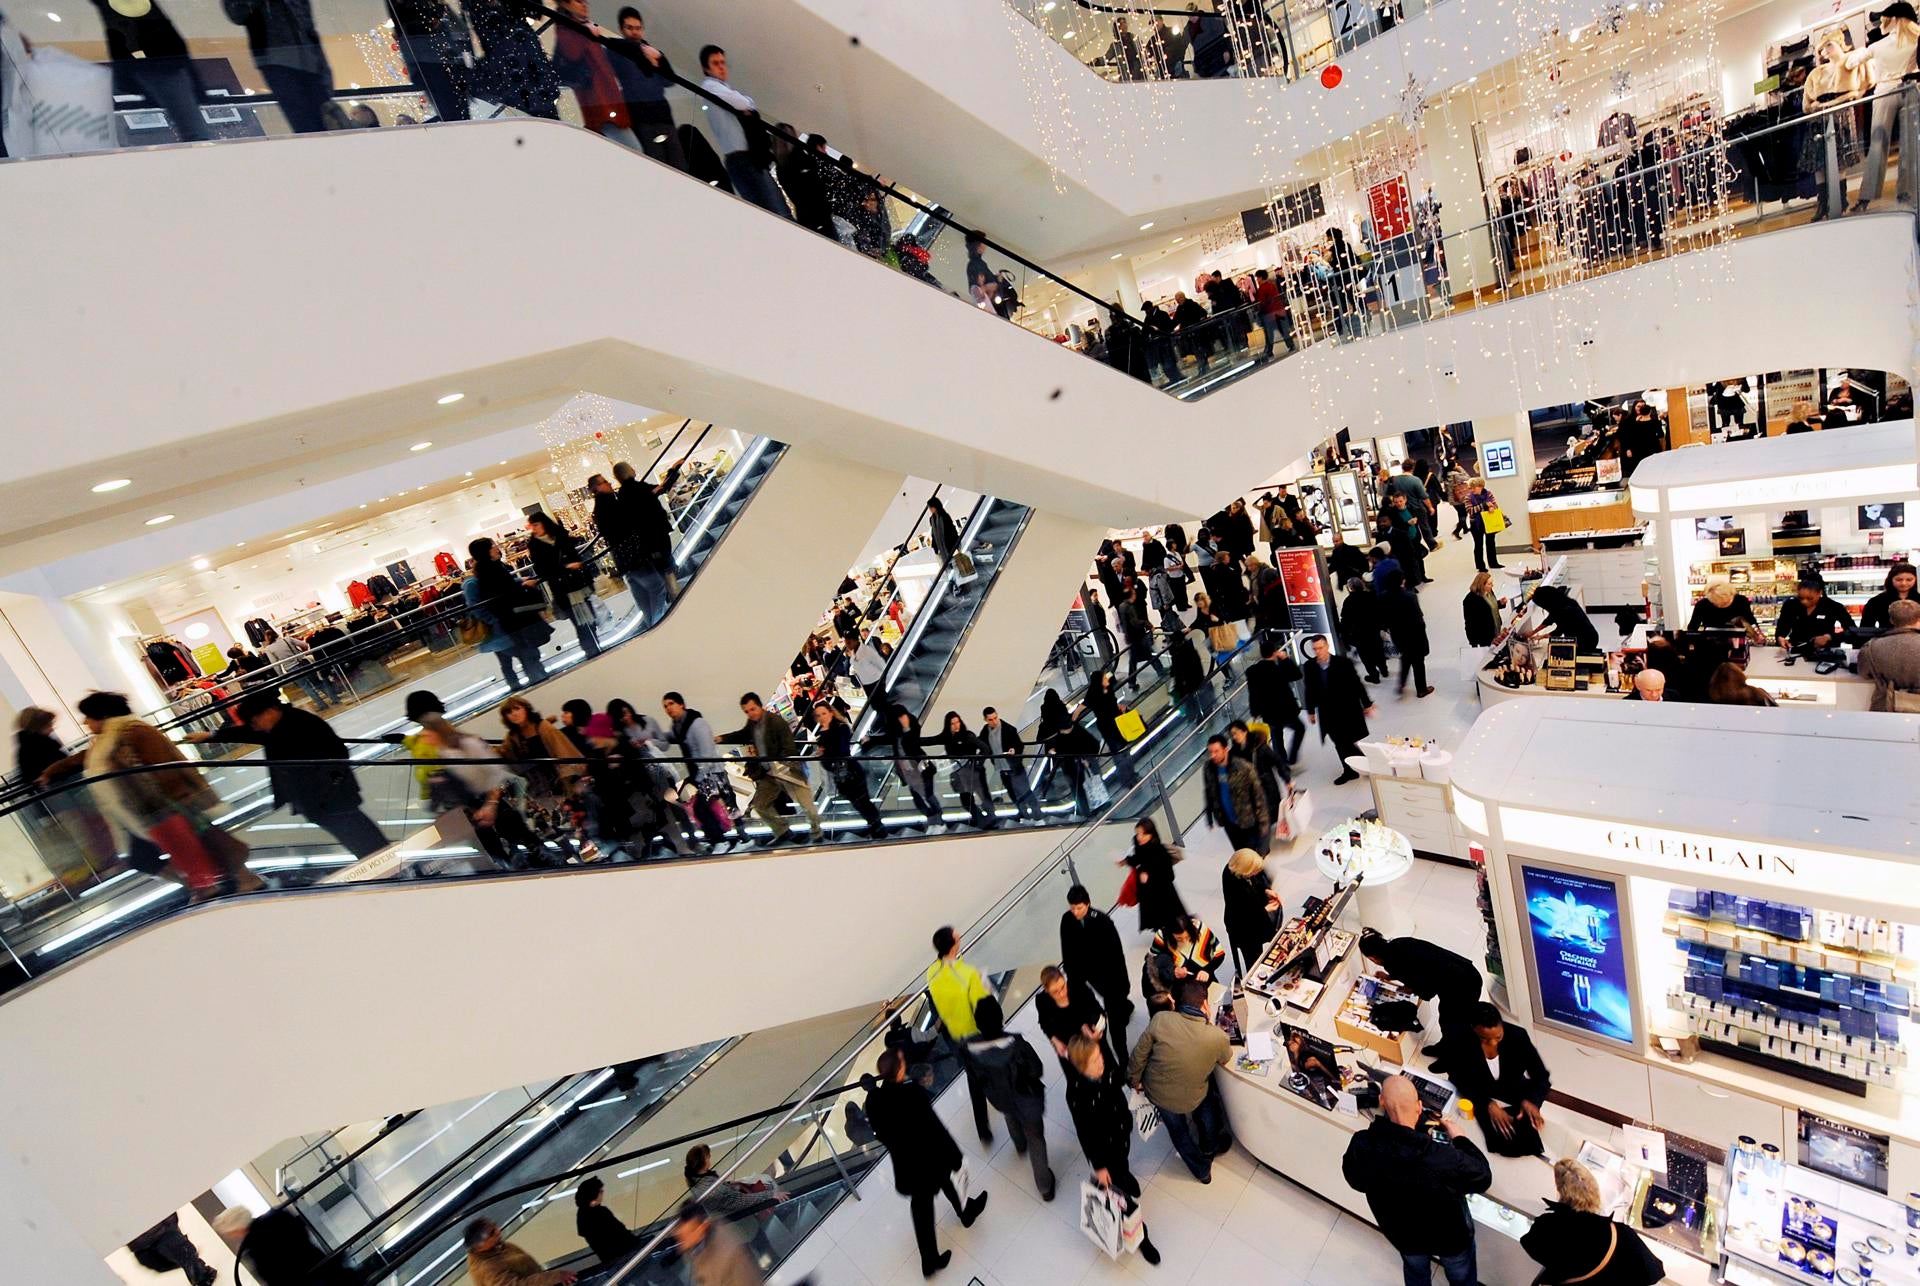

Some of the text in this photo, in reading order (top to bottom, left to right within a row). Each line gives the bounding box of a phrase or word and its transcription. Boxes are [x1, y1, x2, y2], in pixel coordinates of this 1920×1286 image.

[1335, 0, 1357, 35] 2
[1386, 273, 1400, 302] 1
[1607, 830, 1796, 875] GUERLAIN
[1815, 1117, 1870, 1140] GUERLAIN
